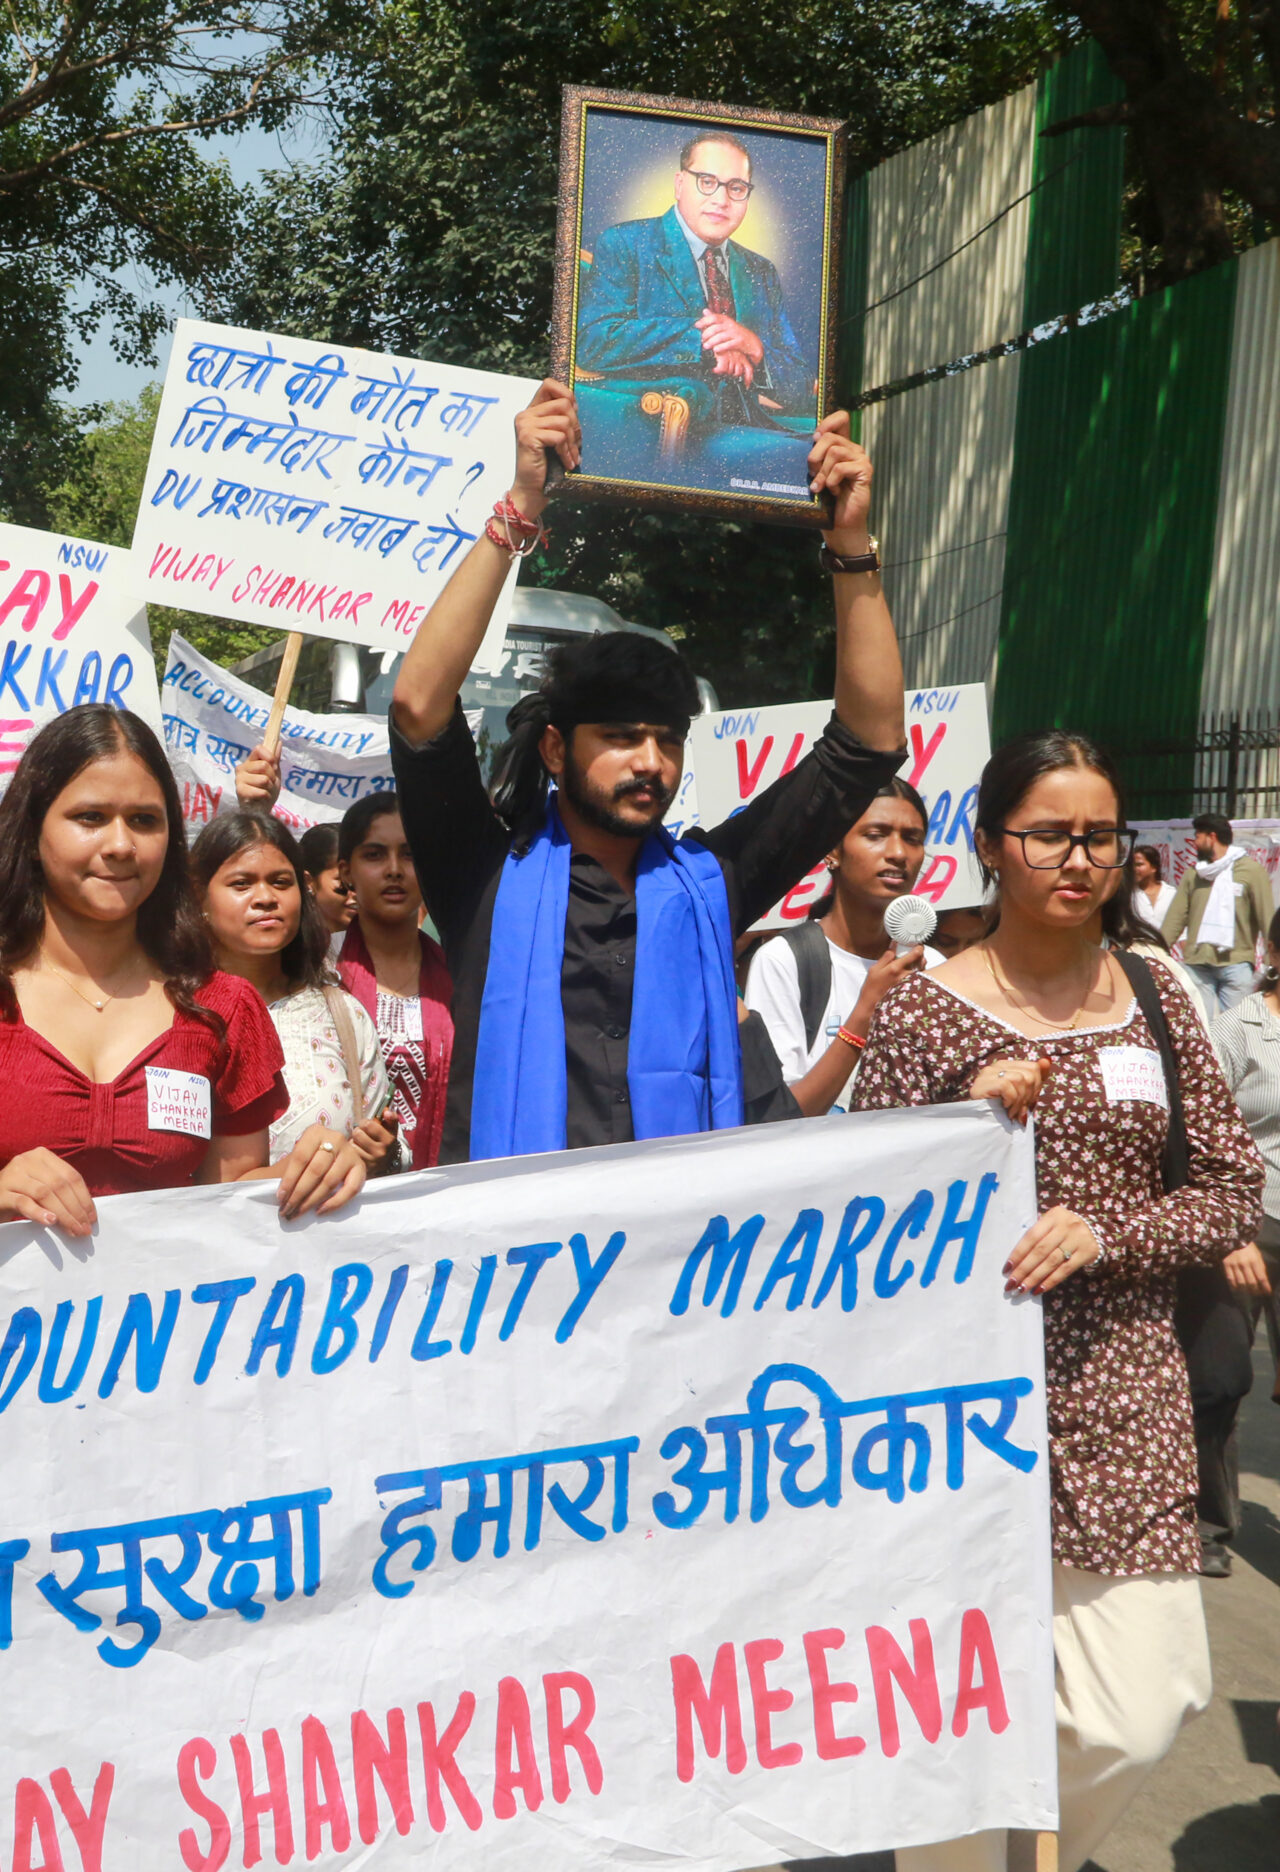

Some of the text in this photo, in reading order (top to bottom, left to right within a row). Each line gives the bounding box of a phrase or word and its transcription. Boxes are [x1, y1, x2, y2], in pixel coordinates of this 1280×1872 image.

[285, 353, 349, 410] की
[350, 366, 440, 432] मौत
[440, 391, 500, 437] का
[170, 396, 358, 480] जिम्मेदार
[455, 461, 486, 513] ?
[151, 469, 203, 511] DU
[197, 477, 330, 533] प्रशासन
[323, 505, 420, 559] जवाब
[57, 541, 110, 573] NSUI
[148, 542, 236, 592] VIJAY
[232, 564, 373, 627] SHANKAR
[714, 689, 961, 740] JOIN NSUI
[285, 764, 367, 799] हमारा
[146, 1068, 170, 1079] JOIN
[1107, 1062, 1156, 1075] VIJAY
[151, 1101, 209, 1120] SHANKKAR
[154, 1084, 198, 1106] VIJAY
[163, 1115, 205, 1134] MEENA
[669, 1171, 1002, 1319] MARCH
[35, 1486, 333, 1669] सुरक्षा
[368, 1435, 641, 1599] हमारा
[651, 1362, 1041, 1531] अधिकार
[176, 1670, 604, 1872] SHANKAR
[669, 1607, 1012, 1785] MEENA
